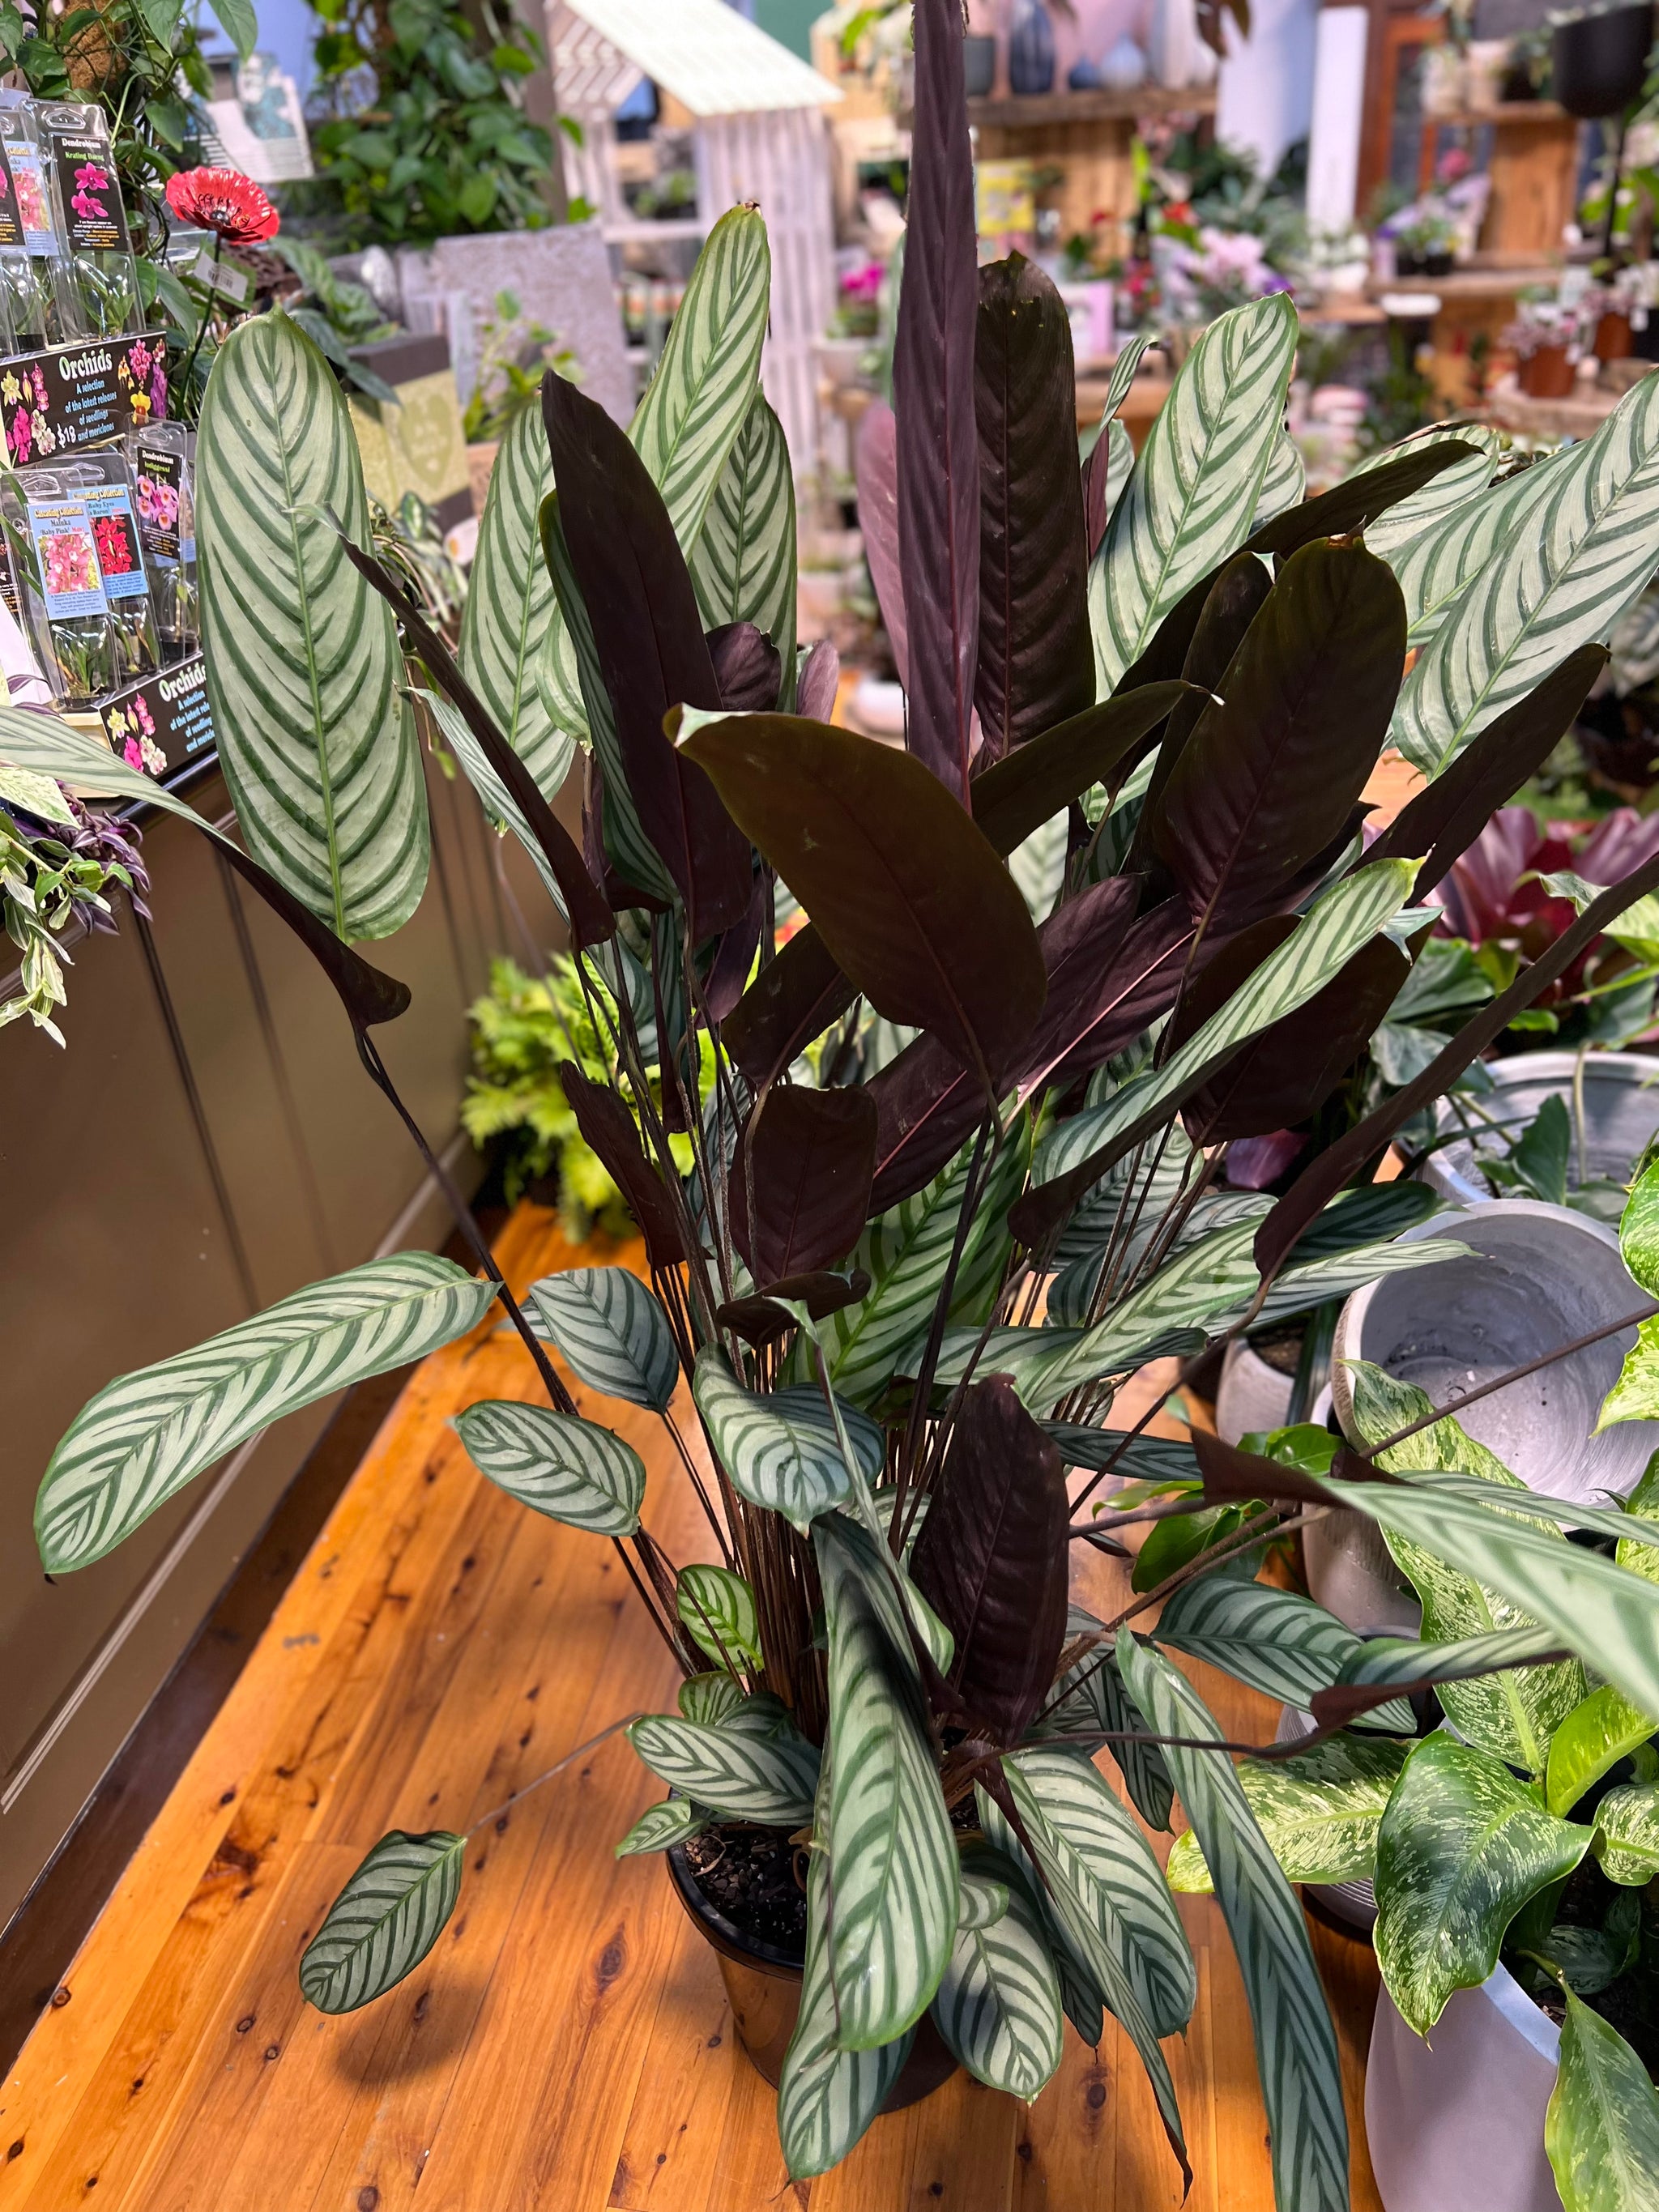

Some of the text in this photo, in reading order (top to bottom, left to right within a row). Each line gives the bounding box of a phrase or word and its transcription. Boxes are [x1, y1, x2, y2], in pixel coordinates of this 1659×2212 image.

[62, 138, 101, 149] Dendrobium
[59, 348, 112, 381] Orchids
[76, 379, 104, 394] A selection
[65, 392, 117, 414] of the latest releases
[79, 409, 109, 425] of seedlings
[57, 422, 76, 449] $18
[77, 428, 88, 441] and
[142, 450, 174, 465] Dendrobium
[177, 690, 206, 711] A selection
[170, 718, 177, 731] of
[176, 715, 187, 727] the
[192, 717, 212, 733] seedling
[186, 737, 198, 752] and
